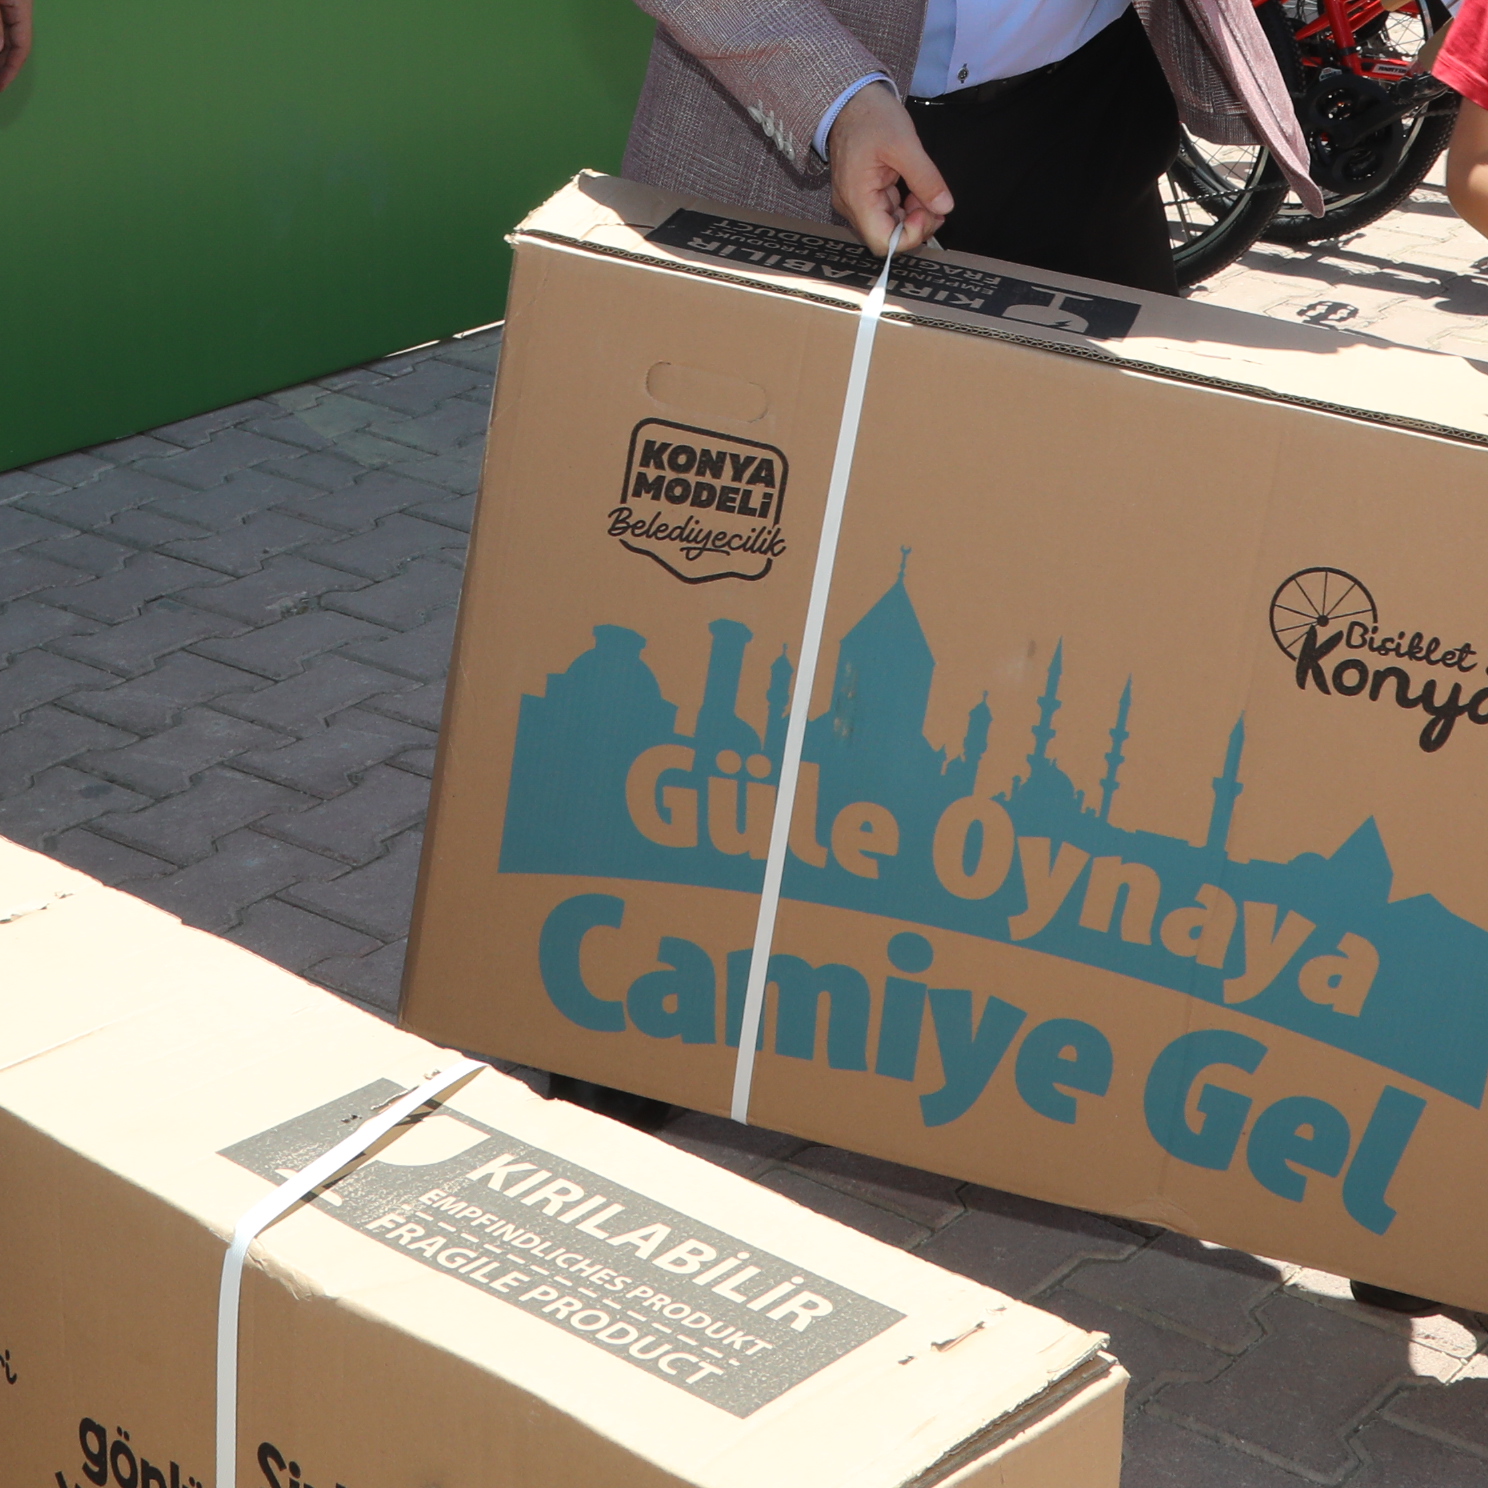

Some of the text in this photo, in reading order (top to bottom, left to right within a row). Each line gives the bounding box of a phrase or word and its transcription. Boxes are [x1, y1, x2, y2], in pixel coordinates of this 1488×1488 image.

[699, 226, 814, 263] PRODUKT
[712, 218, 1002, 287] FRAGIL PRODUCT
[639, 439, 776, 489] KONYA
[607, 506, 787, 561] Belediyecilik
[1344, 620, 1478, 673] Bisiklet
[624, 742, 1381, 1019] Güle Oynaya
[537, 892, 1427, 1236] Camiye Gel
[365, 1212, 725, 1385] FRAGILE PRODUCT
[418, 1187, 777, 1357] EMPFINDLICHES PRODUKT
[465, 1152, 834, 1332] KIRILABİLİR
